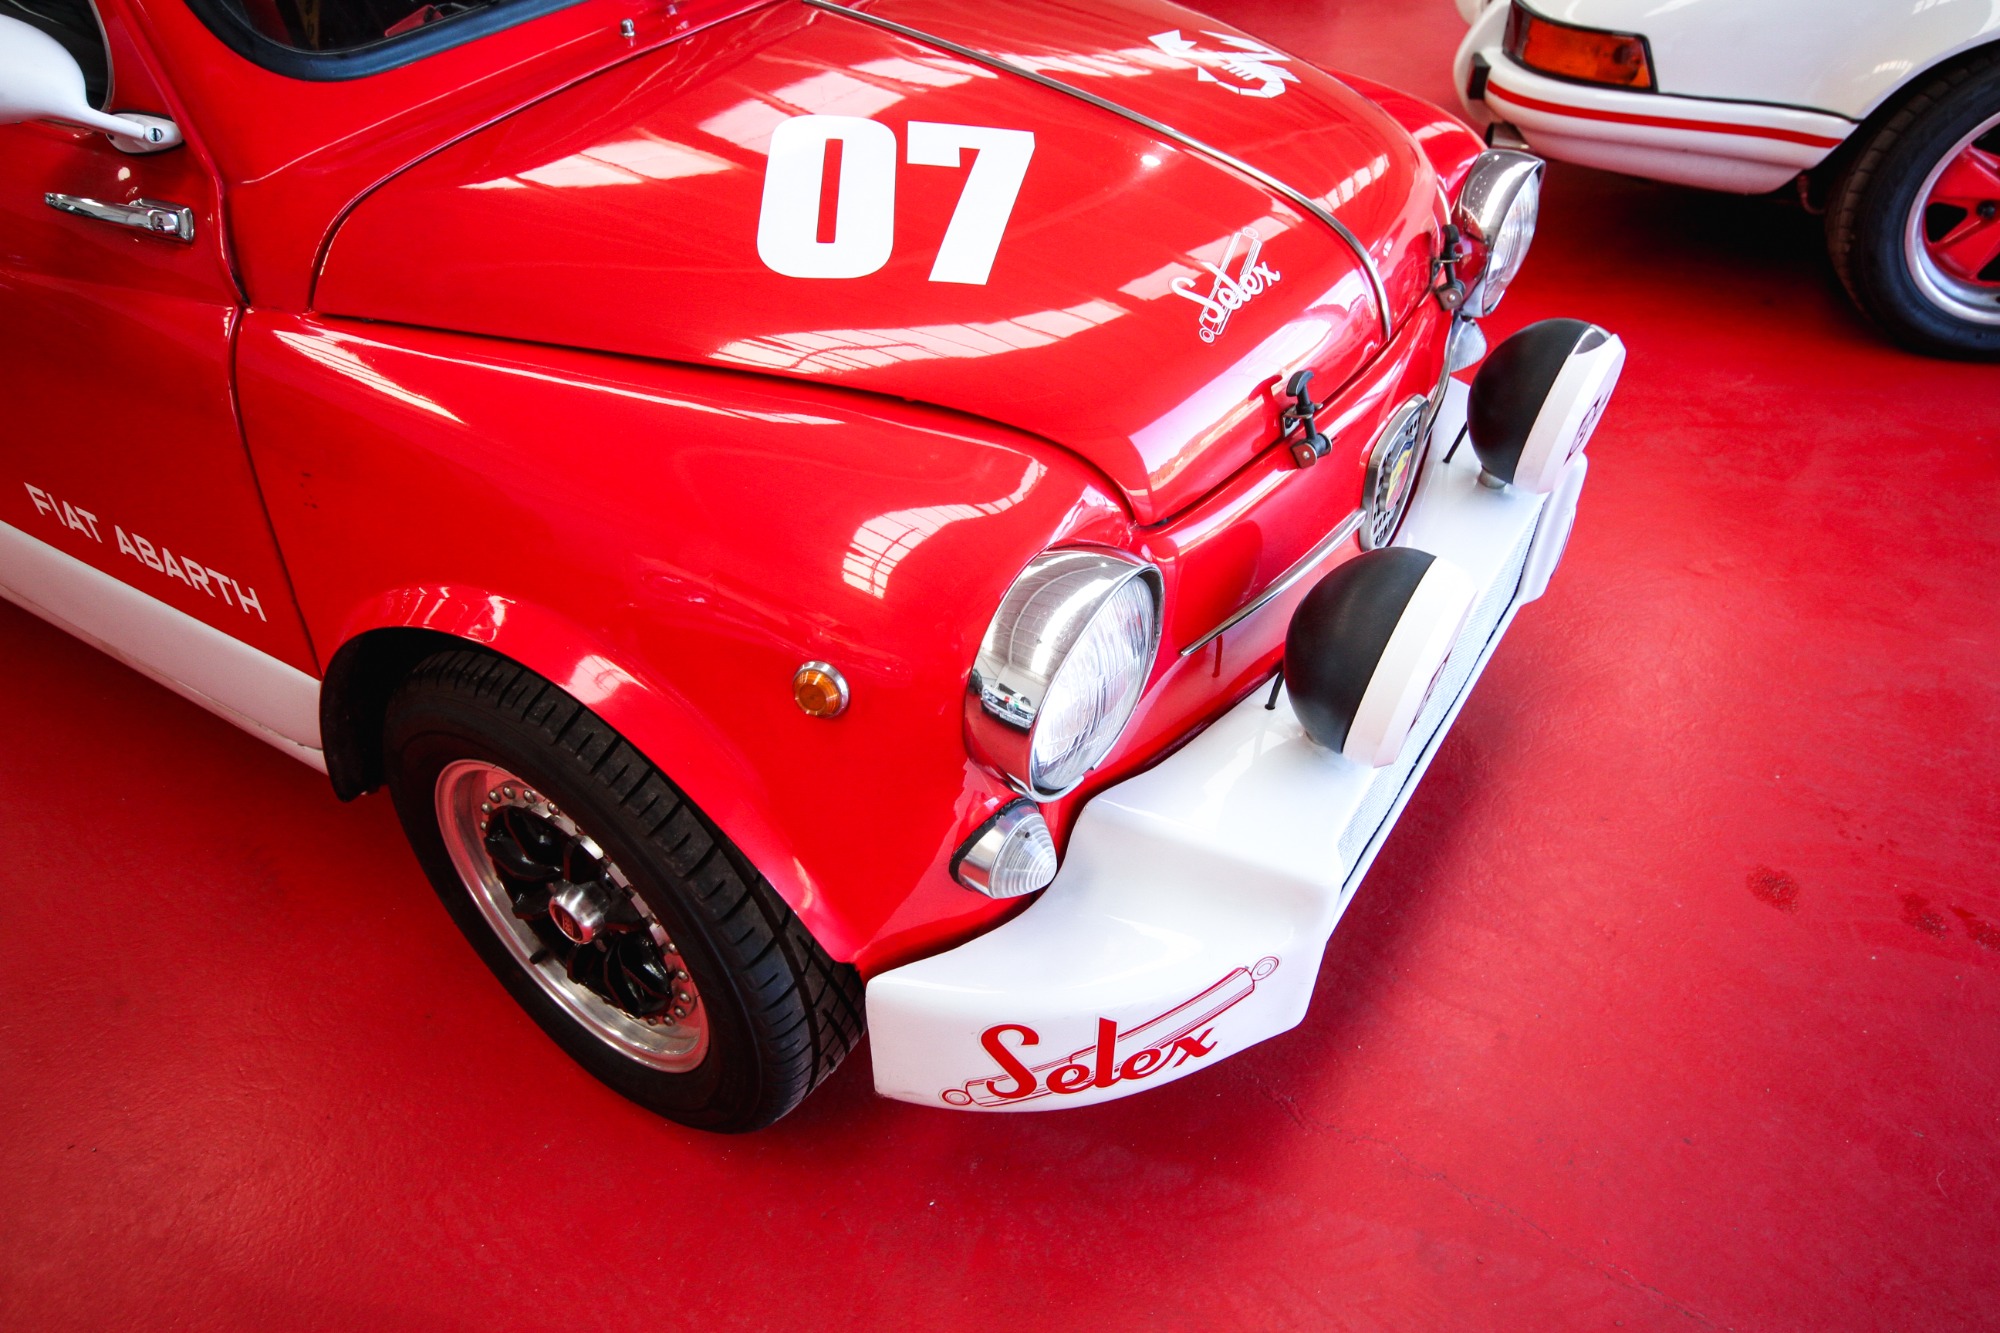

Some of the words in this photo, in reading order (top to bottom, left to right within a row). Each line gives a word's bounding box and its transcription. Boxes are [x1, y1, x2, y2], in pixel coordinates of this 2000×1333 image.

[756, 114, 1036, 286] 07
[1170, 261, 1281, 323] Selex
[24, 481, 103, 544] FIAT
[114, 524, 267, 622] ABARTH
[980, 1016, 1219, 1099] Selex
